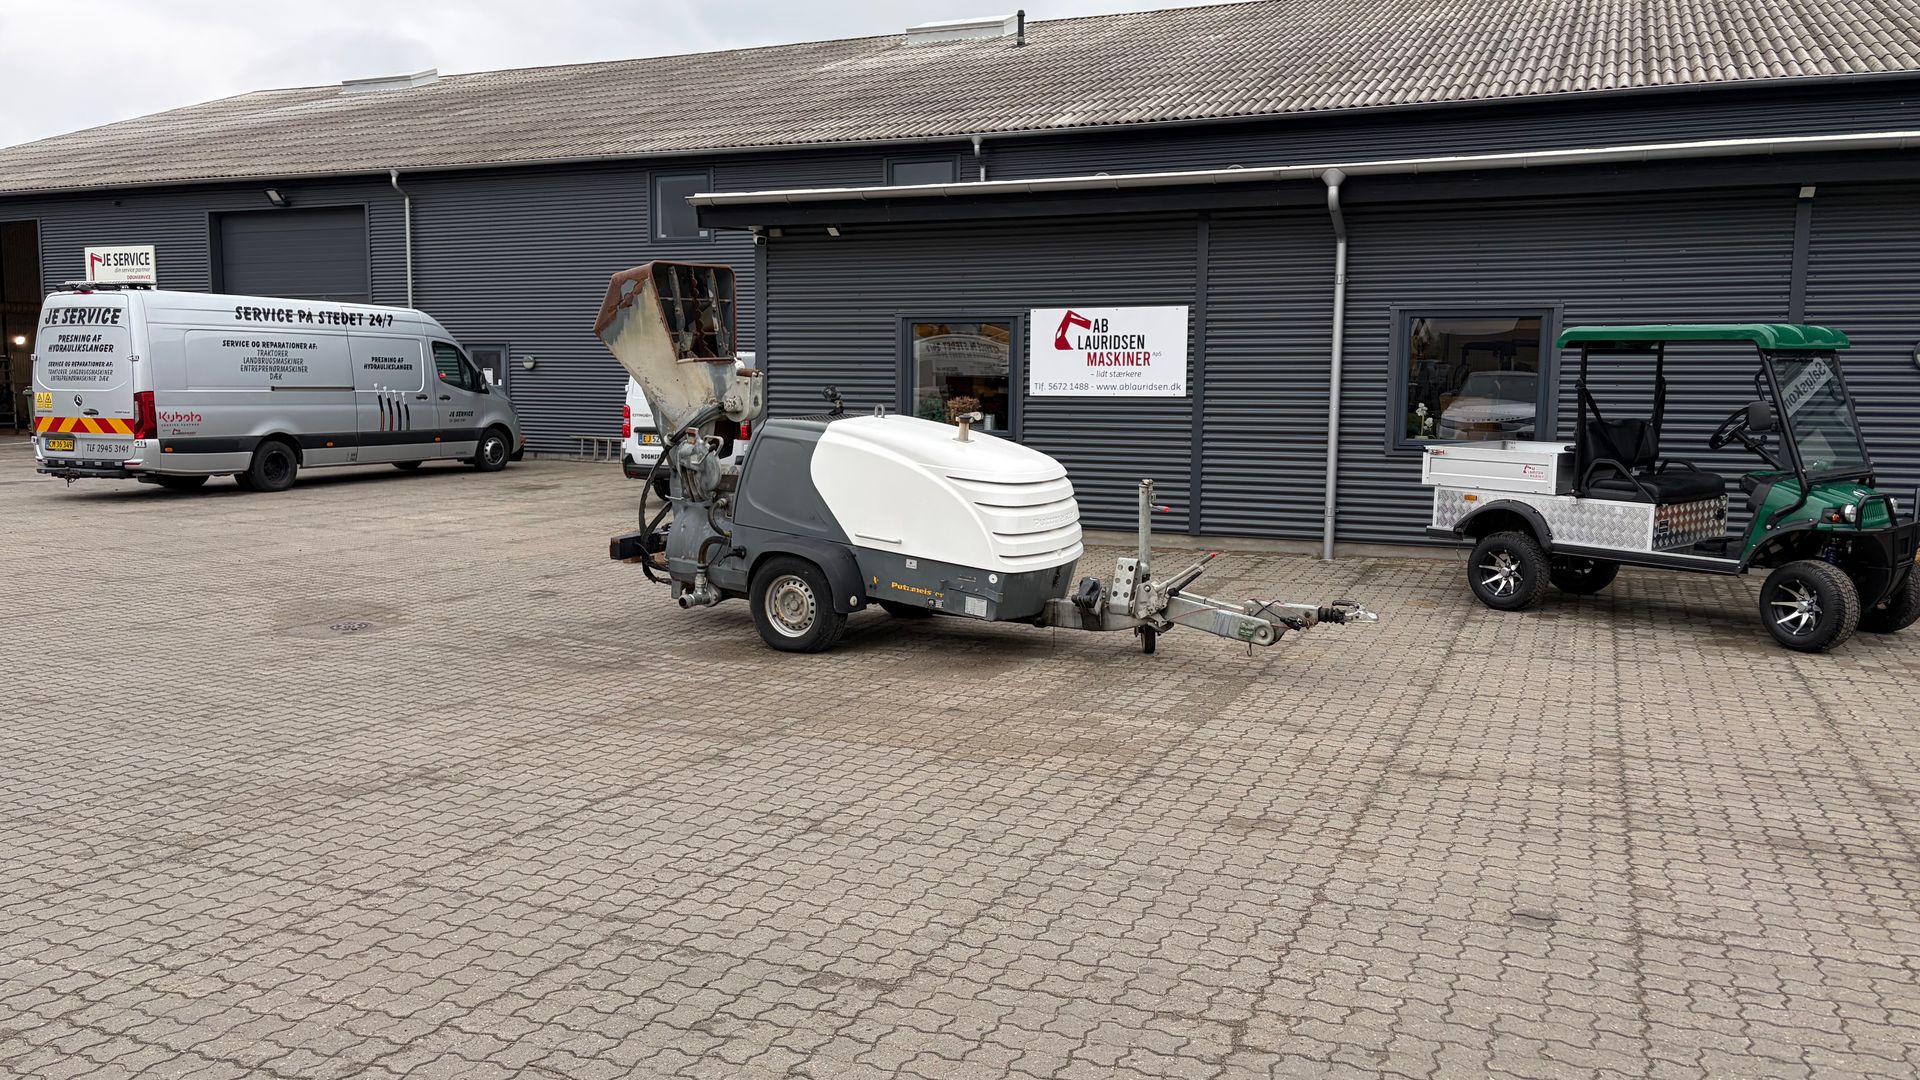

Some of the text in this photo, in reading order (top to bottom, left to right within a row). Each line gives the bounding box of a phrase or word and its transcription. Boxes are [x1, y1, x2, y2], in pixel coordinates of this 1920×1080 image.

[102, 252, 150, 267] JE SERVICE
[45, 308, 122, 325] JE SERVICE
[235, 306, 394, 328] SERVICE PÅ STEDET 24/7
[1092, 318, 1109, 334] AB
[58, 334, 102, 343] PRESNING AF
[1077, 334, 1145, 350] LAURIDSEN
[48, 343, 114, 353] HYDRAULIKSLANGER
[222, 339, 250, 348] SERVICE
[262, 341, 308, 350] REPARATIONER
[257, 349, 289, 357] TRAKTORER
[243, 357, 304, 365] LANDBRUGSMASKINER
[1087, 351, 1151, 367] MASKINER
[240, 364, 308, 373] ENTREPRENØRMASKINER
[363, 363, 413, 371] HYDRAULIKSLANGER
[1096, 370, 1108, 378] lidt
[1109, 370, 1142, 378] stærkere
[1034, 382, 1047, 391] Tlf.
[1048, 382, 1068, 391] 5672
[1070, 382, 1089, 391] 1488
[1096, 382, 1182, 391] www.ablauridsen.dk
[159, 411, 202, 422] Kubota
[97, 444, 113, 453] 2945
[115, 444, 129, 454] 3141
